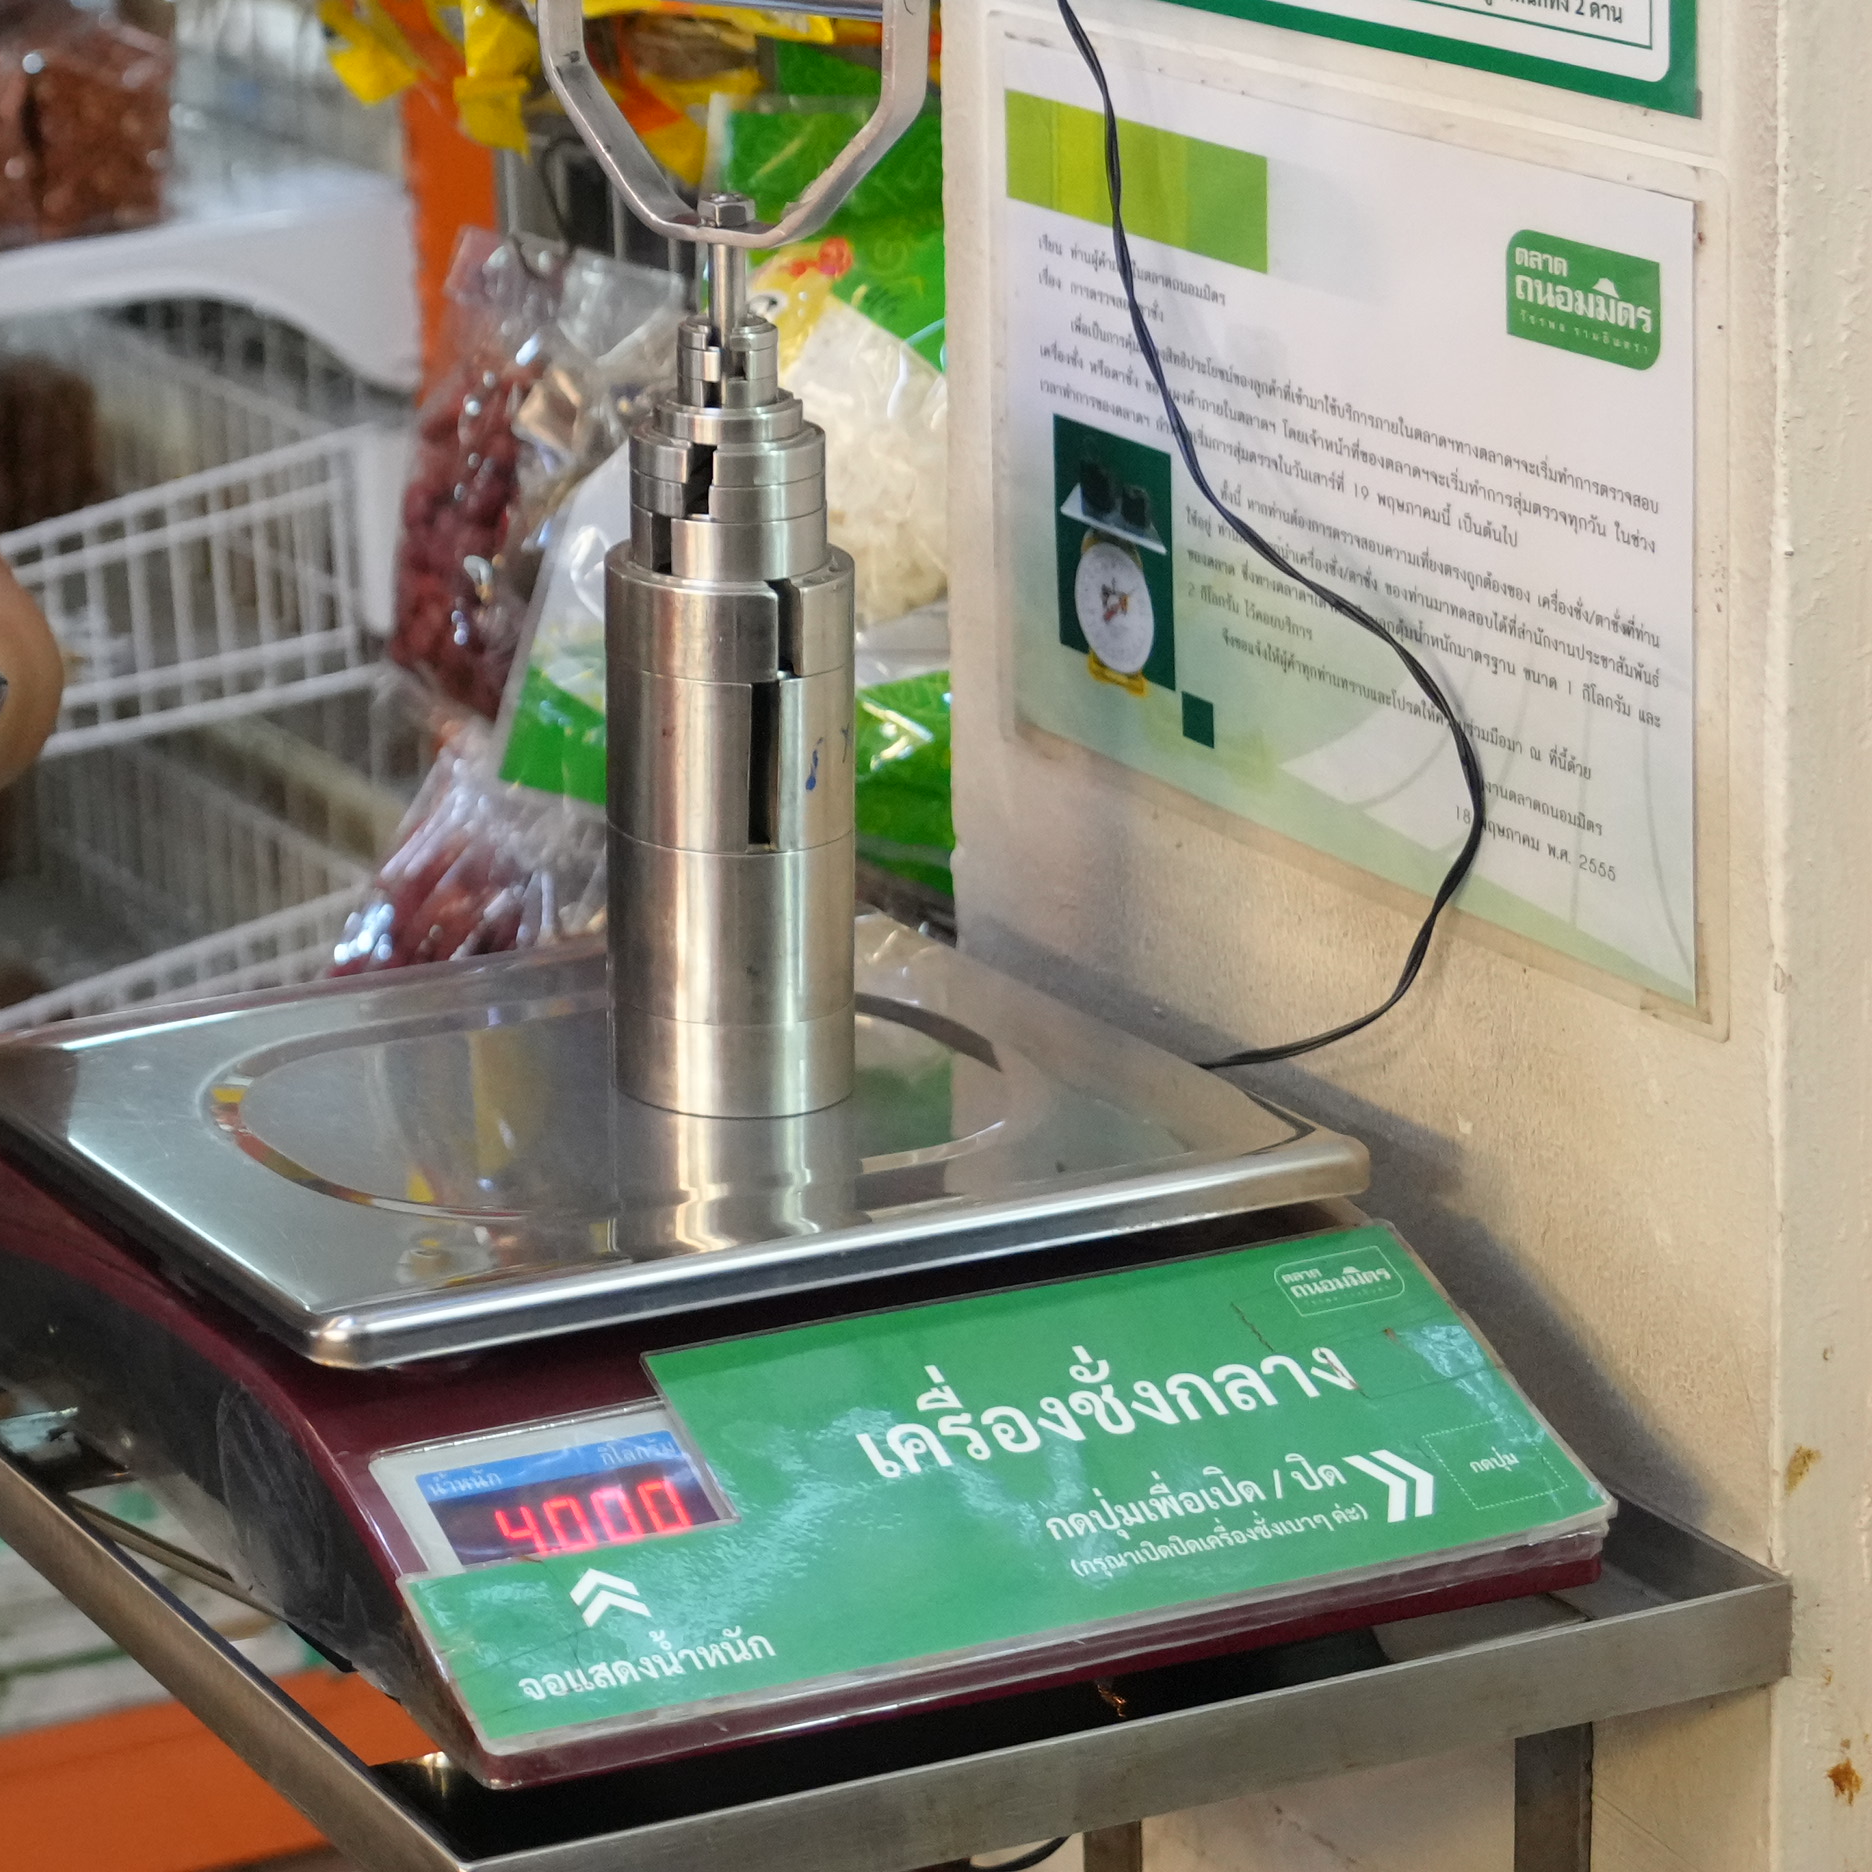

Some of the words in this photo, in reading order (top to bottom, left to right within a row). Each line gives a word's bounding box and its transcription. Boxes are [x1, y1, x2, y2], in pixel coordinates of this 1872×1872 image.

[1039, 235, 1062, 257] เรียน
[1515, 247, 1567, 277] ตลาด
[1515, 275, 1652, 333] ถนอมมิตร
[1354, 482, 1370, 502] 19
[1377, 489, 1451, 528] พฤษภาคมนี้
[1458, 513, 1518, 548] เป็นต้นไป
[1615, 517, 1656, 554] ในช่วง
[1523, 665, 1558, 690] ขนาด
[1582, 683, 1631, 717] กิโลกรัม
[1639, 706, 1661, 728] และ
[1530, 747, 1542, 762] ณ
[1548, 744, 1592, 780] ที่นี้ด้วย
[1455, 805, 1472, 825] 18
[1482, 819, 1540, 853] ฤษภาคม
[1547, 842, 1571, 865] พ.ศ.
[1578, 854, 1617, 882] 2555
[1281, 1268, 1323, 1284] ตลาด
[1290, 1266, 1392, 1299] ถนอมมิตร
[857, 1343, 1357, 1485] เครื่องชั่งกลาง
[427, 1467, 503, 1498] น้ำหนัก
[1469, 1449, 1519, 1477] กดปุ่ม
[1046, 1466, 1266, 1542] กดปุ่มเพื่อเปิด
[1284, 1452, 1346, 1491] ปิด
[1070, 1510, 1328, 1578] (กรุณาเปิดปิดเครื่องชั่งเบาๆ
[1331, 1502, 1368, 1530] ค่ะ)
[518, 1625, 777, 1702] จอแสดงน้ำหนัก
